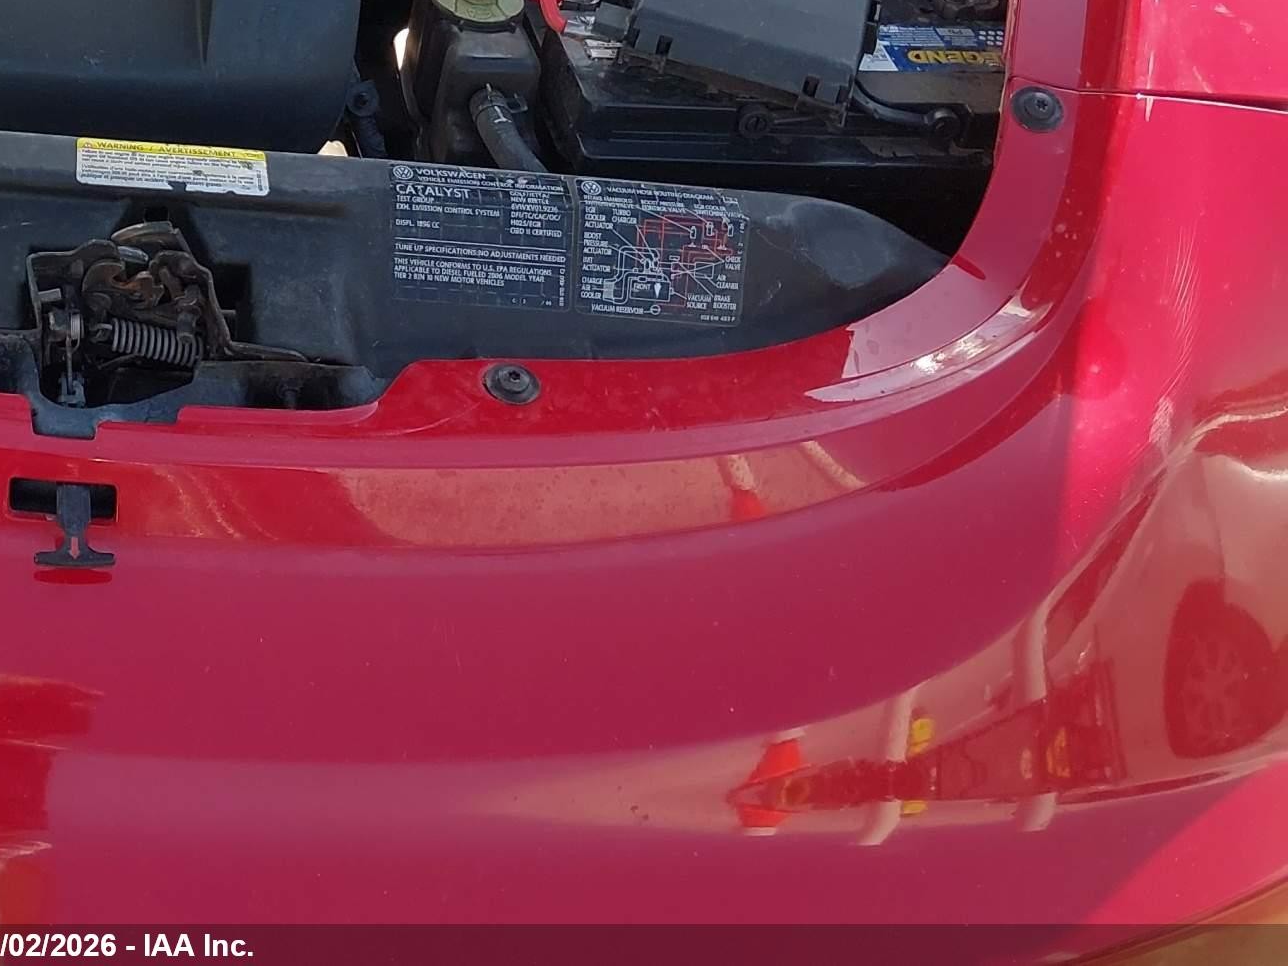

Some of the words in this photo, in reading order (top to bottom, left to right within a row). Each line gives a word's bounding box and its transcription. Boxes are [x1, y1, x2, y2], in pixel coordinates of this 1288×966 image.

[907, 49, 1005, 65] EGEND
[96, 141, 144, 150] WARNING
[158, 146, 235, 157] AVERTISSEMENT
[415, 168, 486, 179] VOLKSWAGEN
[396, 184, 471, 199] CATALYST
[515, 183, 565, 192] INFORMATION
[606, 186, 636, 194] VACUUM
[683, 192, 714, 200] DIAGRAM
[412, 204, 443, 213] EMISSION
[444, 206, 474, 215] CONTROL
[475, 208, 500, 217] SYSTEM
[612, 208, 632, 216] TURBO
[611, 216, 637, 224] CHARGER
[432, 221, 440, 229] CC
[583, 221, 614, 229] ACTUATOR
[532, 228, 563, 238] CERTIFIED
[583, 231, 602, 240] BOOST
[583, 239, 609, 247] PRESSURE
[394, 243, 413, 251] TUNE
[414, 244, 424, 252] UP
[490, 250, 539, 261] ADJUSTMENTS
[540, 254, 567, 263] NEEDED
[583, 246, 612, 255] ACTUATOR
[394, 257, 409, 265] THIS
[409, 258, 435, 267] VEHICLE
[435, 260, 471, 270] CONFORMS
[496, 265, 508, 273] EPA
[509, 266, 553, 276] REGULATIONS
[582, 263, 611, 273] ACTUATOR
[725, 263, 741, 271] VALVE
[394, 265, 430, 274] APPLICABLE
[441, 268, 462, 276] DIESEL
[463, 269, 486, 278] FUELED
[504, 273, 527, 281] MODEL
[413, 273, 425, 281] BIN
[434, 274, 450, 282] NEW
[450, 275, 475, 284] MOTOR
[475, 277, 505, 287] VEHICLES
[581, 276, 603, 284] CHARGE
[633, 282, 651, 291] FRONT
[716, 281, 739, 290] CLEANER
[580, 291, 602, 299] COOLER
[687, 294, 712, 302] VACUUM
[713, 294, 731, 302] BRAKE
[591, 303, 616, 312] VACUUM
[616, 305, 644, 315] RESERVOIR
[686, 301, 707, 310] SOURCE
[713, 302, 737, 311] BOOSTER
